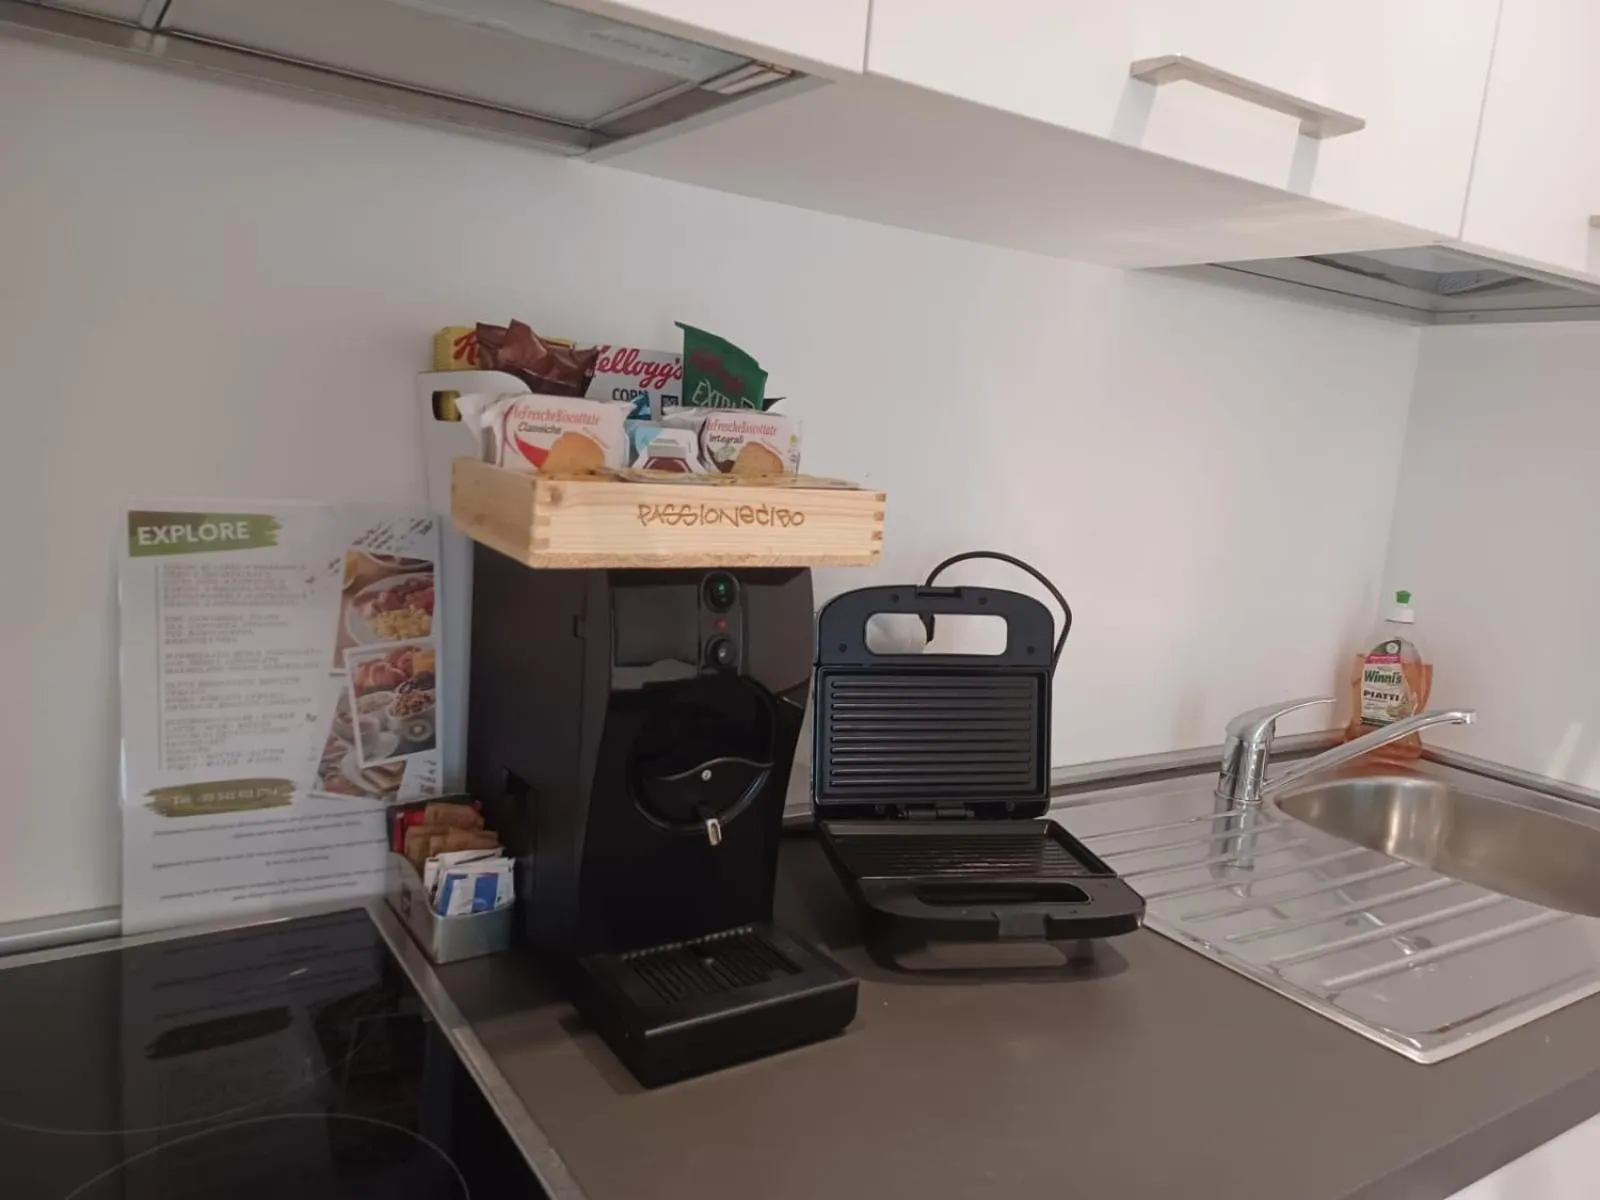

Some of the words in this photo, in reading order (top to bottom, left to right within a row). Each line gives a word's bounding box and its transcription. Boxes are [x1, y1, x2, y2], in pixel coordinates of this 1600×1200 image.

[597, 344, 683, 389] ellogg's
[612, 387, 648, 402] COR
[137, 520, 250, 546] EXPLORE
[1364, 669, 1403, 684] Winni's
[1363, 690, 1400, 701] PIATTI
